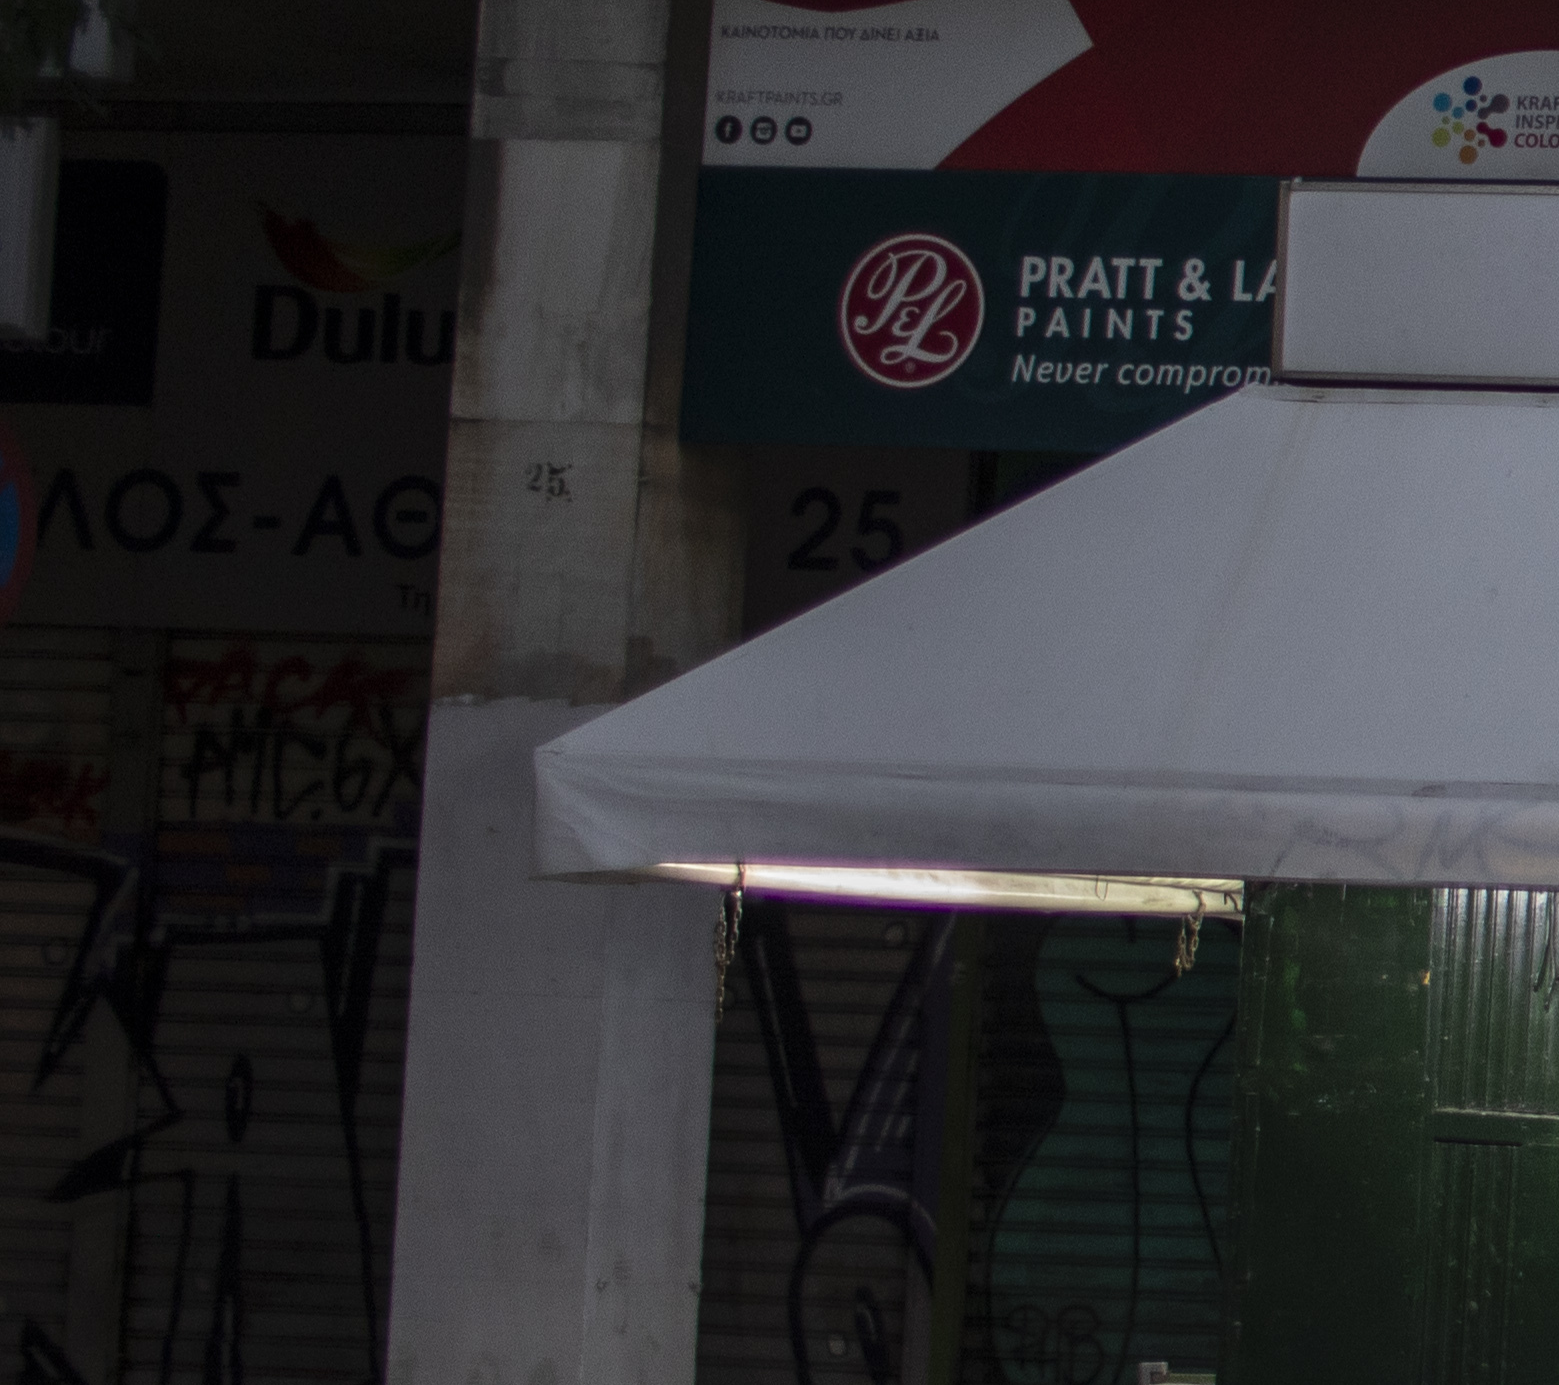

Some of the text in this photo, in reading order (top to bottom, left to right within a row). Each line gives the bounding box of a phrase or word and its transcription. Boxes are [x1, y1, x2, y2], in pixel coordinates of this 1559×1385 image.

[824, 26, 857, 41] ΠΟΥ
[716, 90, 844, 106] KRAFTPAINTS.GR
[1018, 255, 1163, 300] PRATT
[1177, 259, 1212, 301] &
[1017, 307, 1195, 342] PAINTS
[1011, 354, 1282, 395] Never comprom
[786, 487, 904, 574] 25
